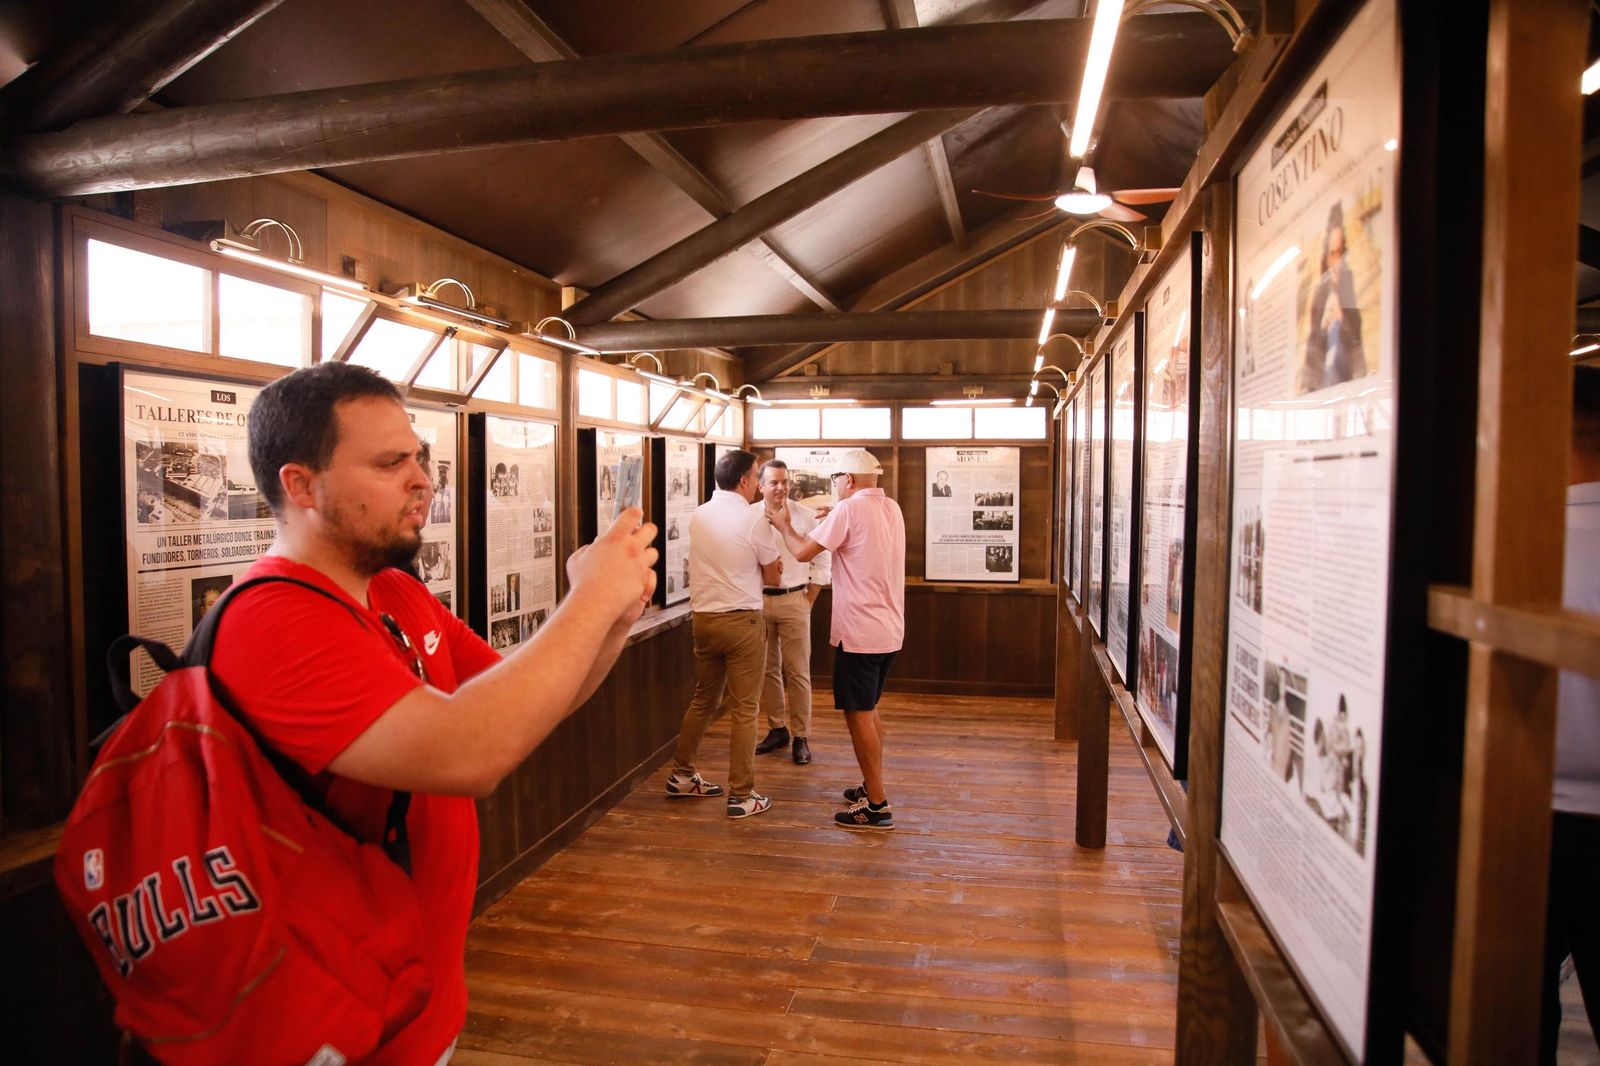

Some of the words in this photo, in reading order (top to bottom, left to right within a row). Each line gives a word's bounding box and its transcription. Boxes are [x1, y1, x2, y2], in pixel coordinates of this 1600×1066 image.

[1258, 106, 1343, 226] COSENTINO
[216, 392, 231, 402] LOS
[135, 404, 212, 424] TALLERES
[216, 411, 233, 426] DE
[157, 536, 167, 548] UN
[168, 535, 192, 547] TALLER
[193, 531, 234, 546] METALÚRGICO
[234, 531, 252, 542] DONDE
[221, 544, 256, 558] SOLDADORES
[256, 544, 261, 554] Y
[87, 845, 262, 978] BULLS
